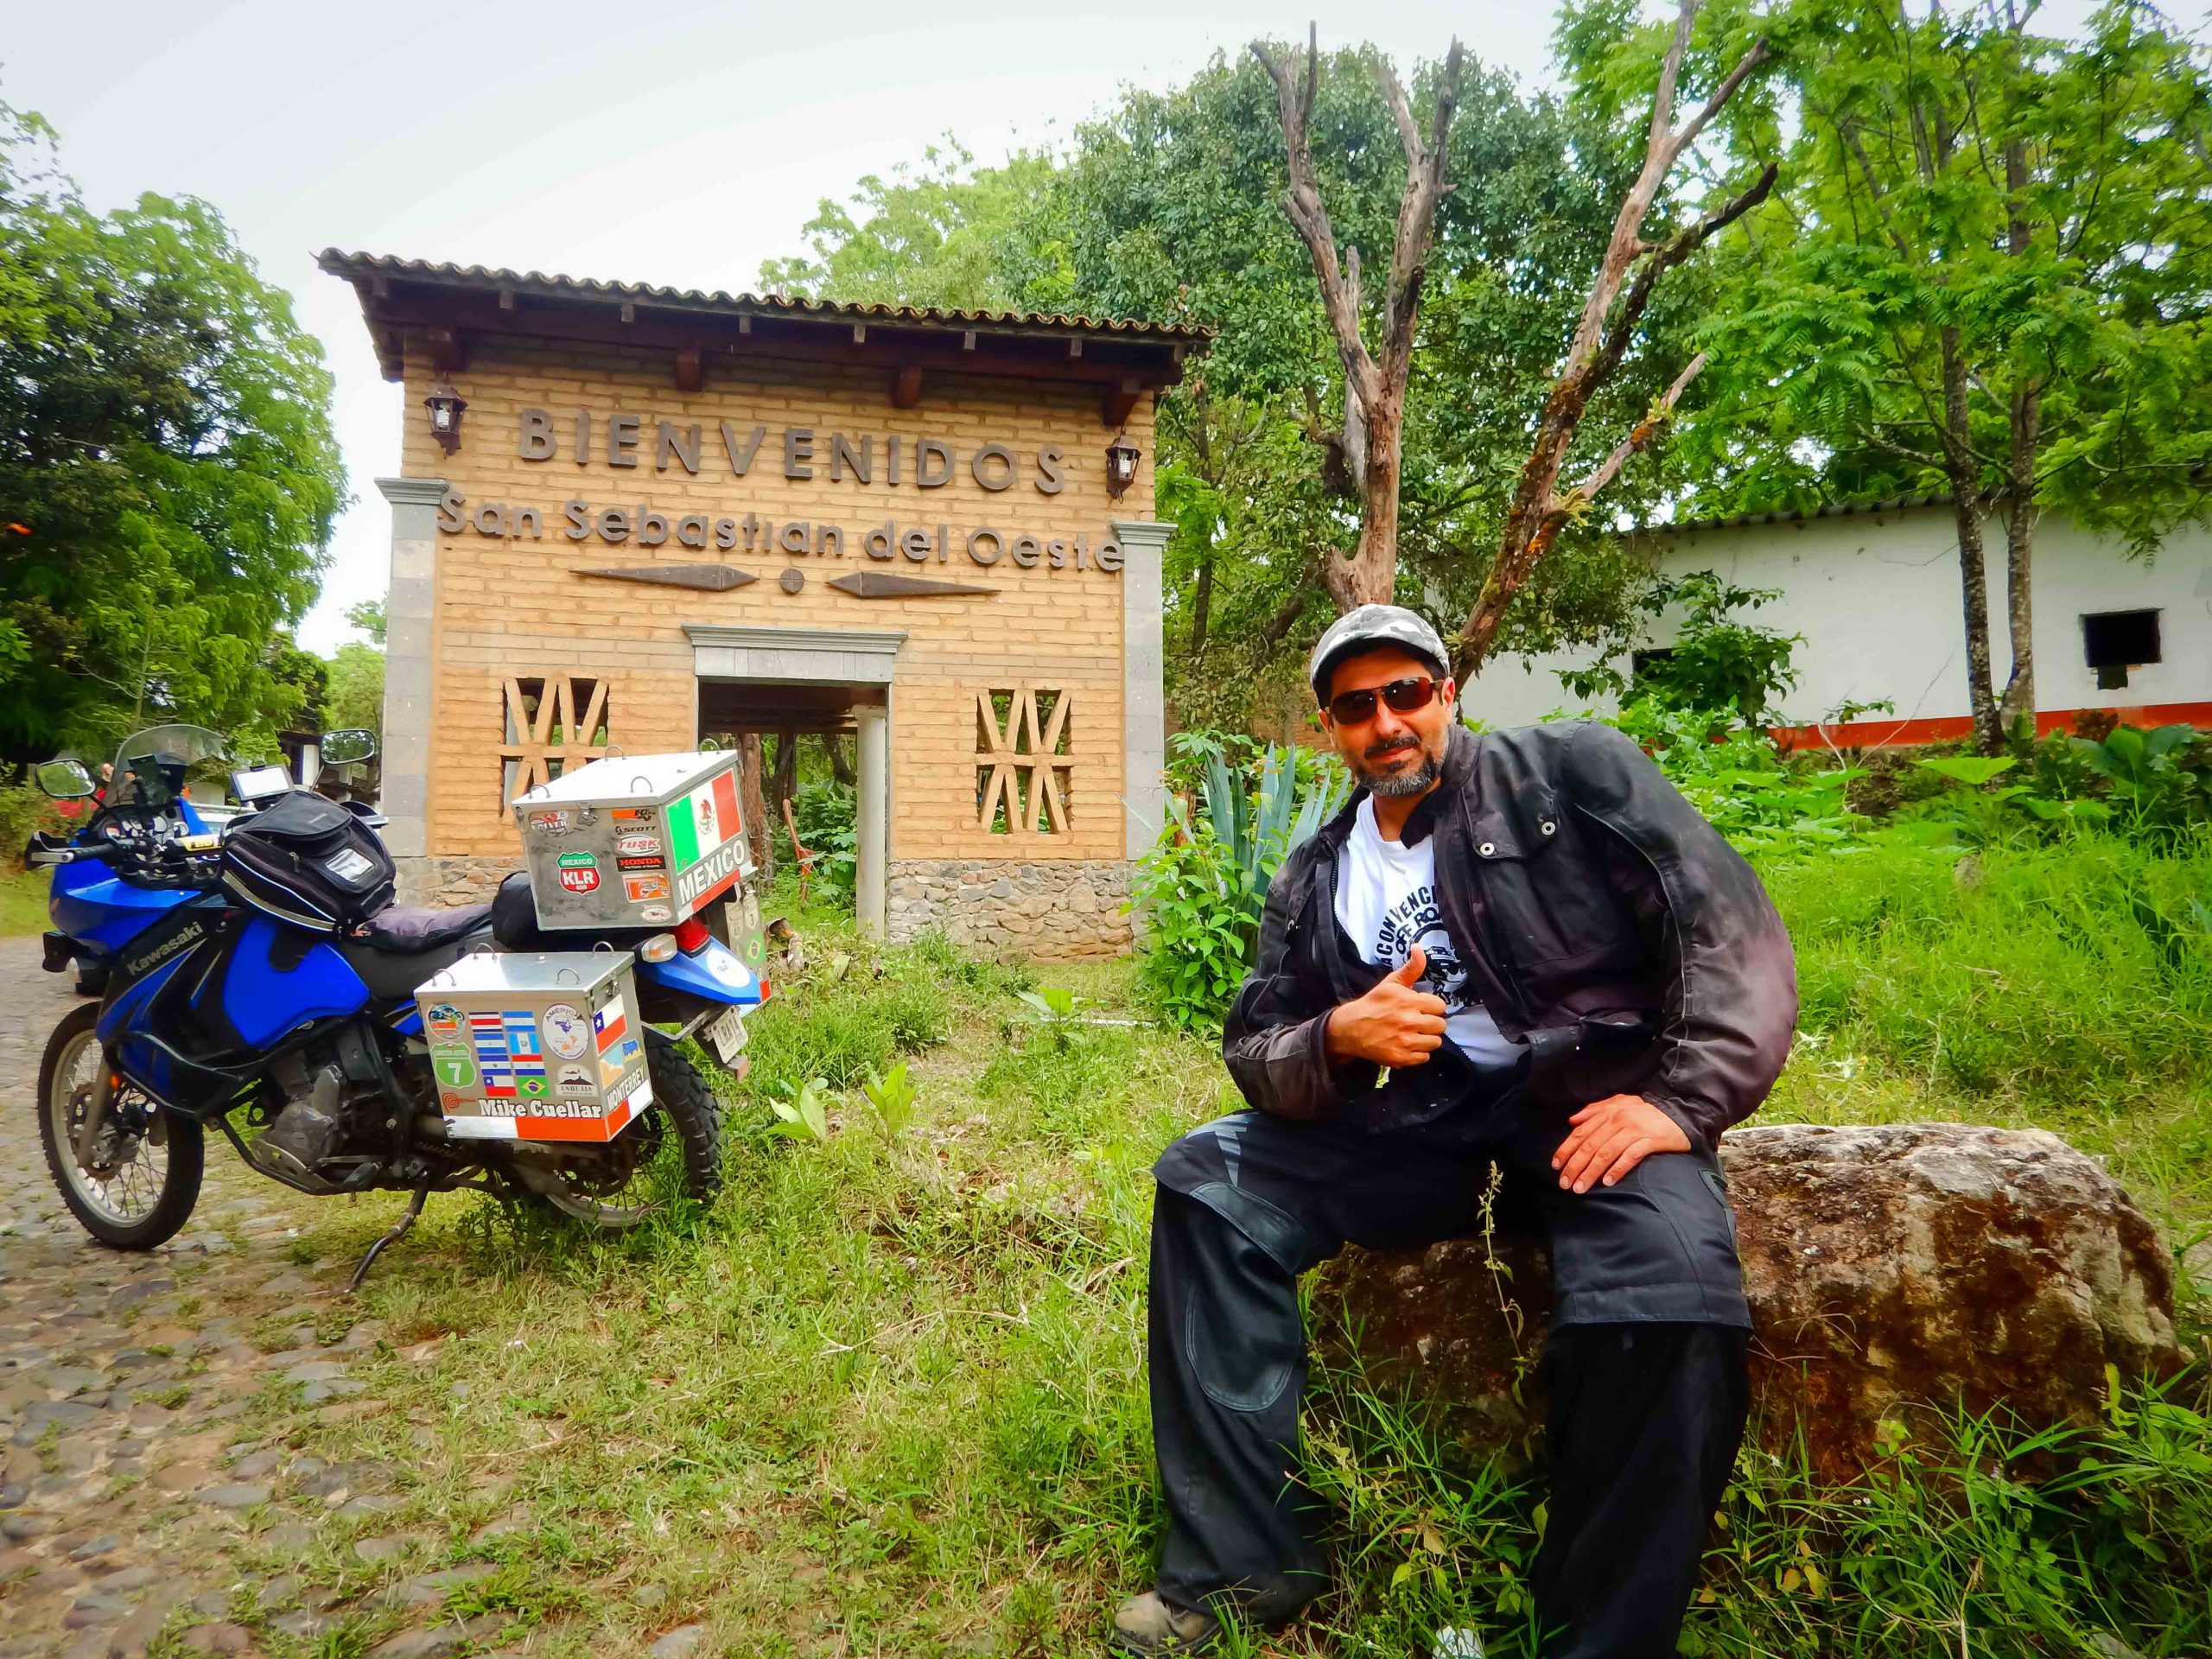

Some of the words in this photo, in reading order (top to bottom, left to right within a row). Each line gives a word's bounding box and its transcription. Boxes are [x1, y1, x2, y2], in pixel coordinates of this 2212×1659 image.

[519, 407, 1067, 495] BIENVENIDOS
[436, 489, 543, 540] San
[564, 498, 844, 558] Sebastian
[863, 518, 948, 563] del
[966, 524, 1125, 573] Oeste
[617, 839, 659, 850] TUSK
[620, 857, 663, 866] HONDA
[678, 840, 745, 906] MEXICO
[563, 871, 594, 885] KLR
[127, 921, 203, 976] Kawasaki
[1395, 924, 1412, 955] OFF
[448, 1063, 461, 1084] 7
[607, 1065, 645, 1112] MONTERREY
[477, 1098, 528, 1118] Mike
[530, 1098, 603, 1119] Cuellar
